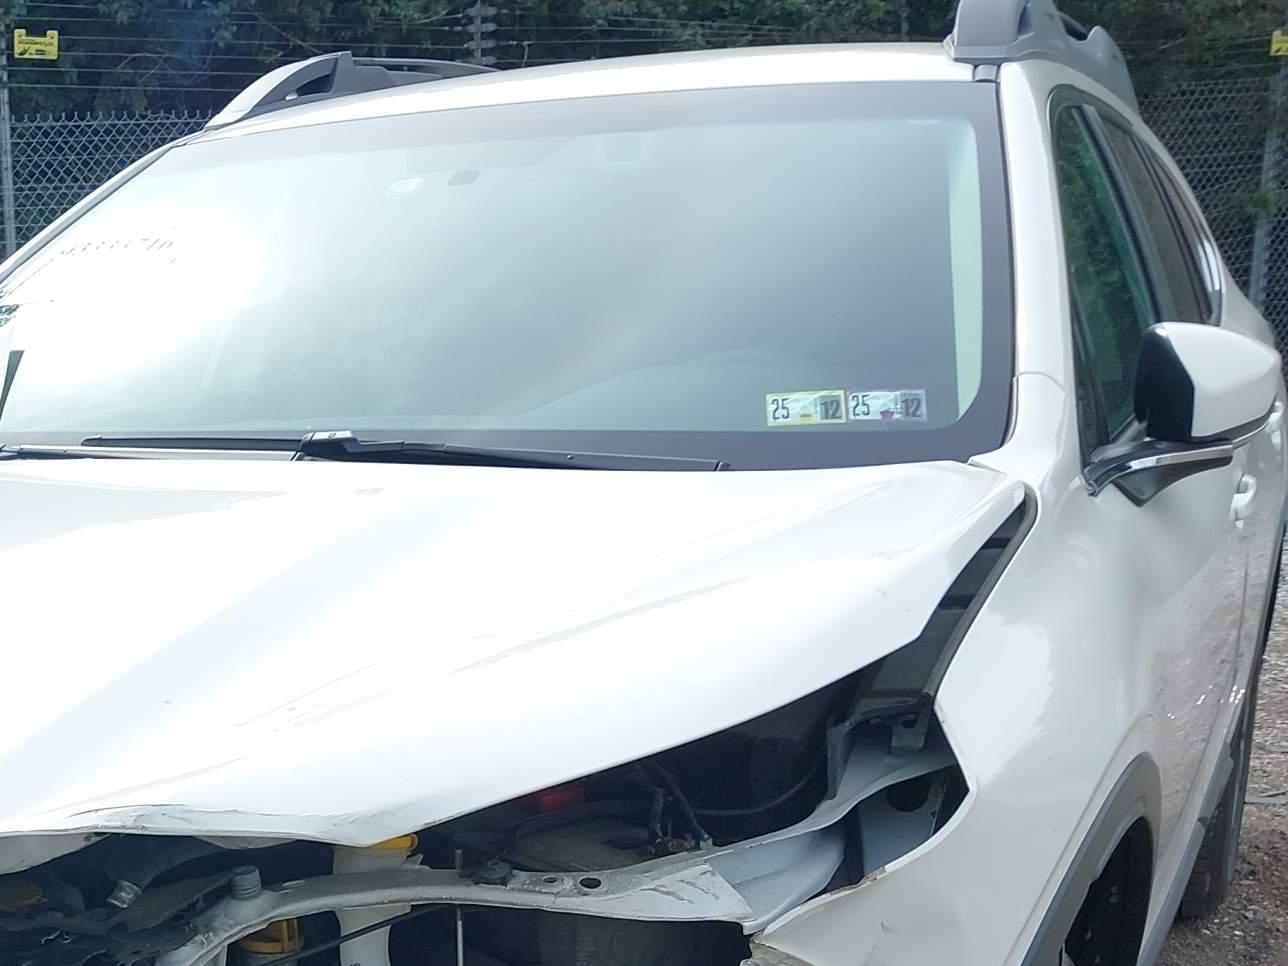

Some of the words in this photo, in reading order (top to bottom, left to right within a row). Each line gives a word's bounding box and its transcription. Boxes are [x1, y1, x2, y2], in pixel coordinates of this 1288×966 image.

[771, 398, 790, 420] 25
[820, 399, 842, 420] 12
[851, 394, 871, 417] 25
[901, 397, 922, 418] 12
